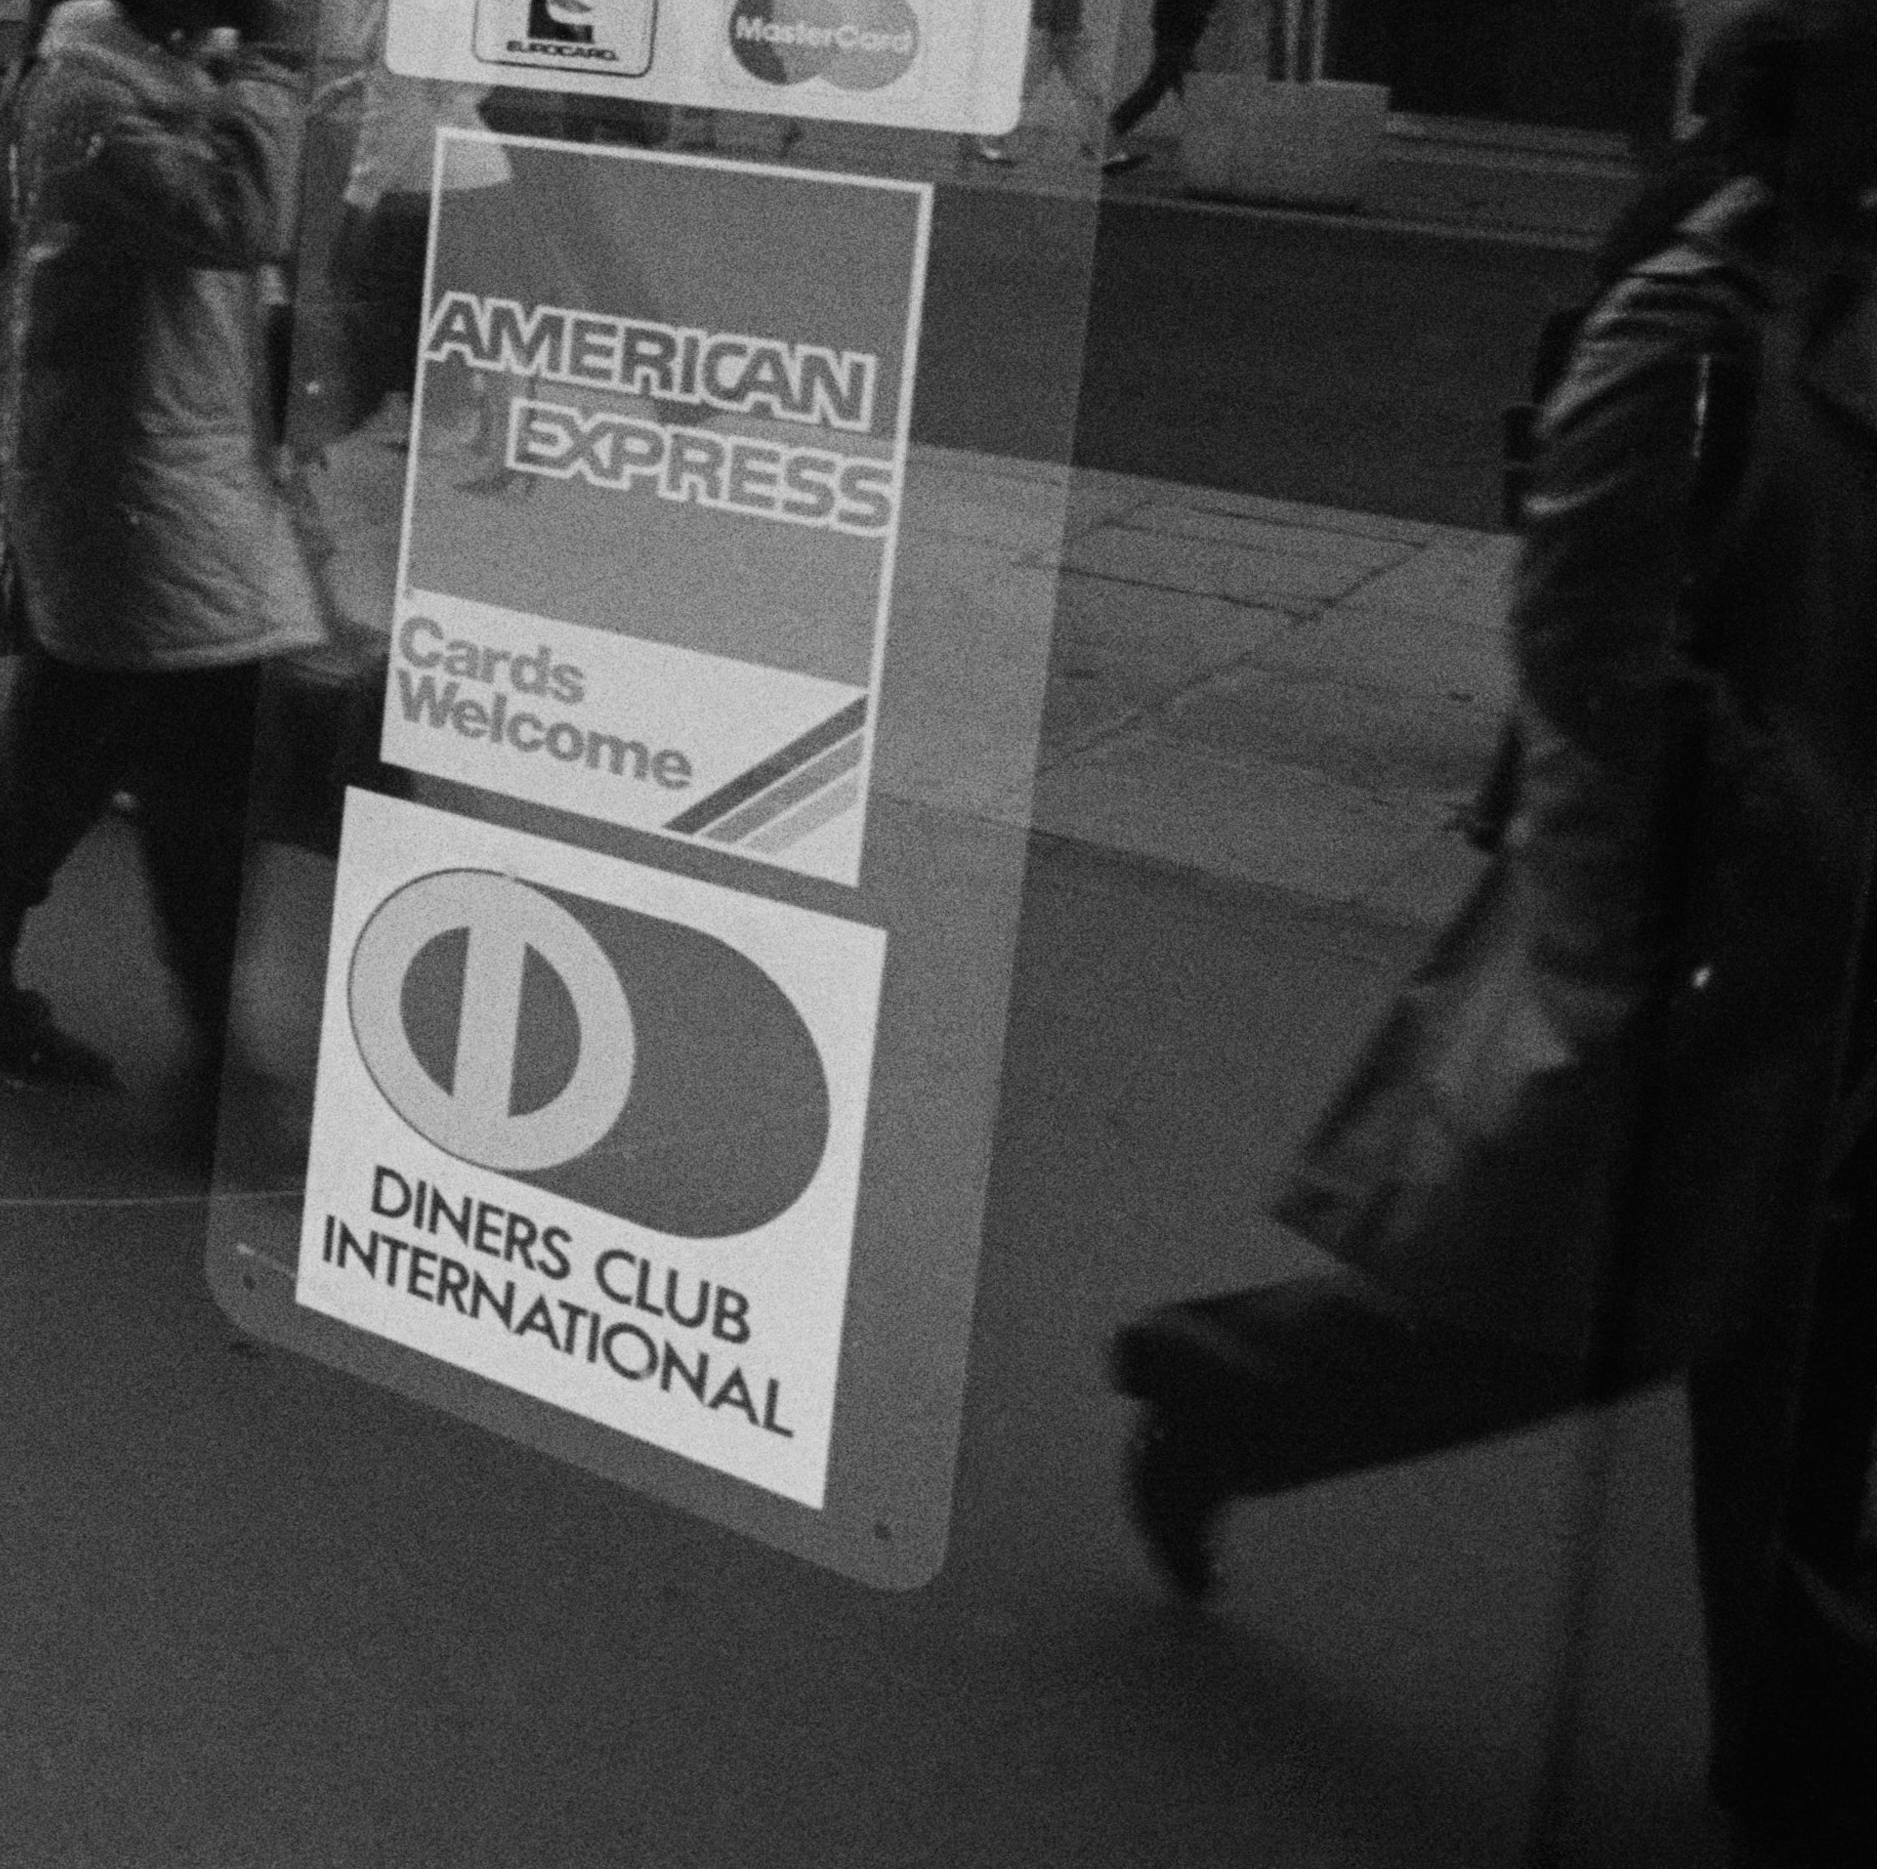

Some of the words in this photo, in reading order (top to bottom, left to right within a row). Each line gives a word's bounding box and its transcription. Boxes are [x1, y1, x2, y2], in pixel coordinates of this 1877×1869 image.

[735, 14, 914, 57] MasterCard
[423, 290, 876, 432] AMERICAN
[505, 398, 899, 539] EXPRESS
[396, 667, 694, 792] Welcome
[397, 615, 586, 706] Cards
[370, 1163, 573, 1282] DINERS
[594, 1248, 753, 1345] CLUB
[322, 1213, 796, 1439] INTERNATIONAL
